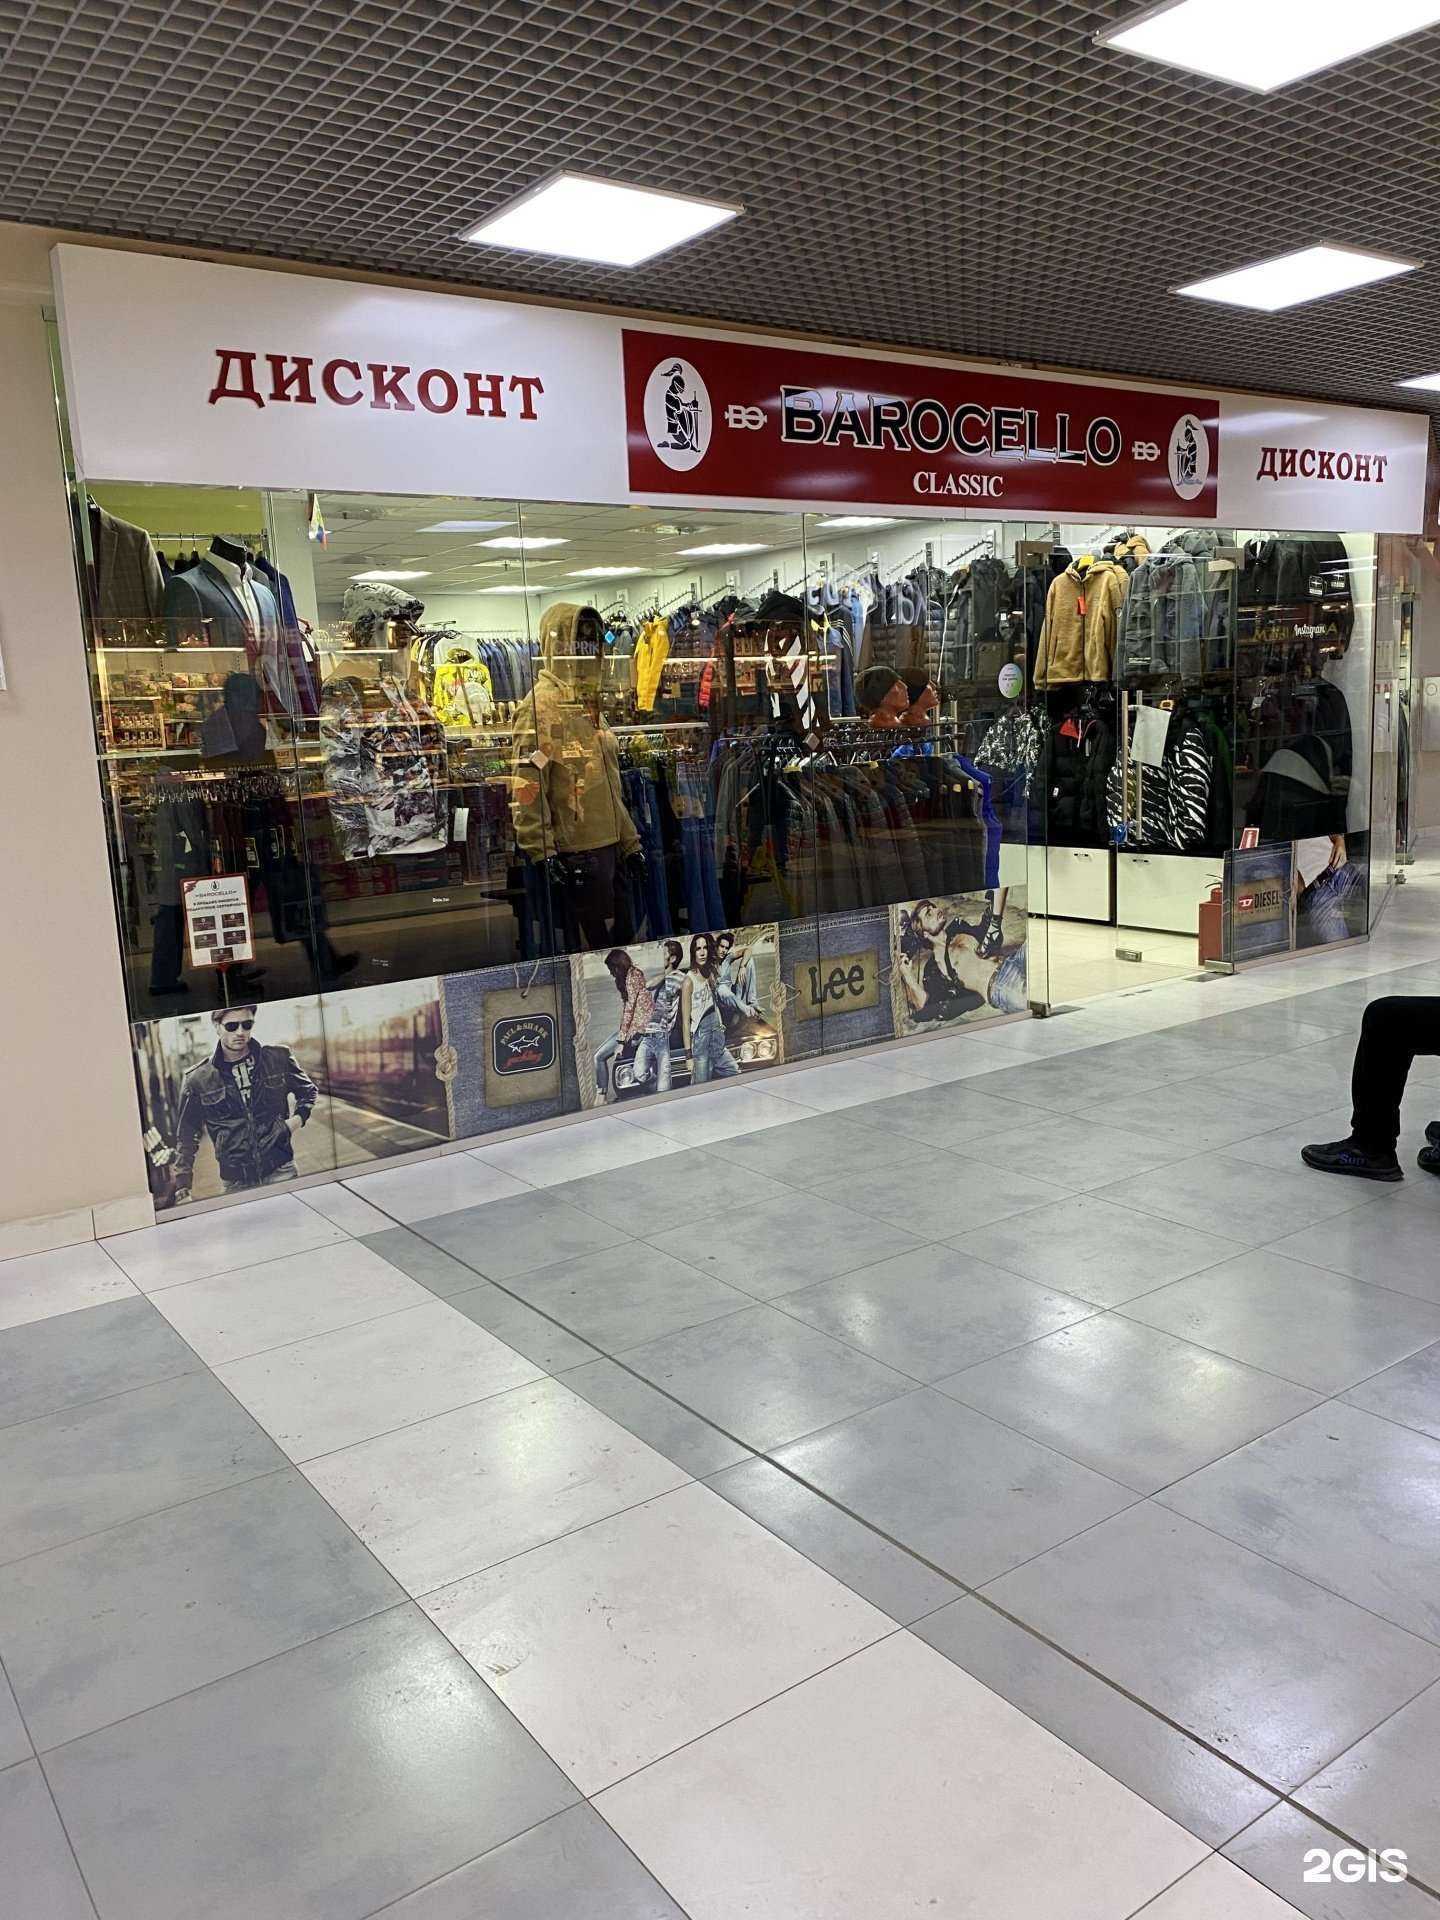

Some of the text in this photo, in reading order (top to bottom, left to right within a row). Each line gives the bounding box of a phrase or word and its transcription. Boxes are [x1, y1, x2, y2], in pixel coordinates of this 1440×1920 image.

[208, 349, 544, 421] ДИСКОНТ
[779, 385, 1122, 467] BAROCELLO
[912, 470, 1004, 498] CLASSIC
[1256, 446, 1388, 483] ДИСКОНТ
[1253, 888, 1280, 909] DIESEL
[808, 964, 864, 1005] Lee
